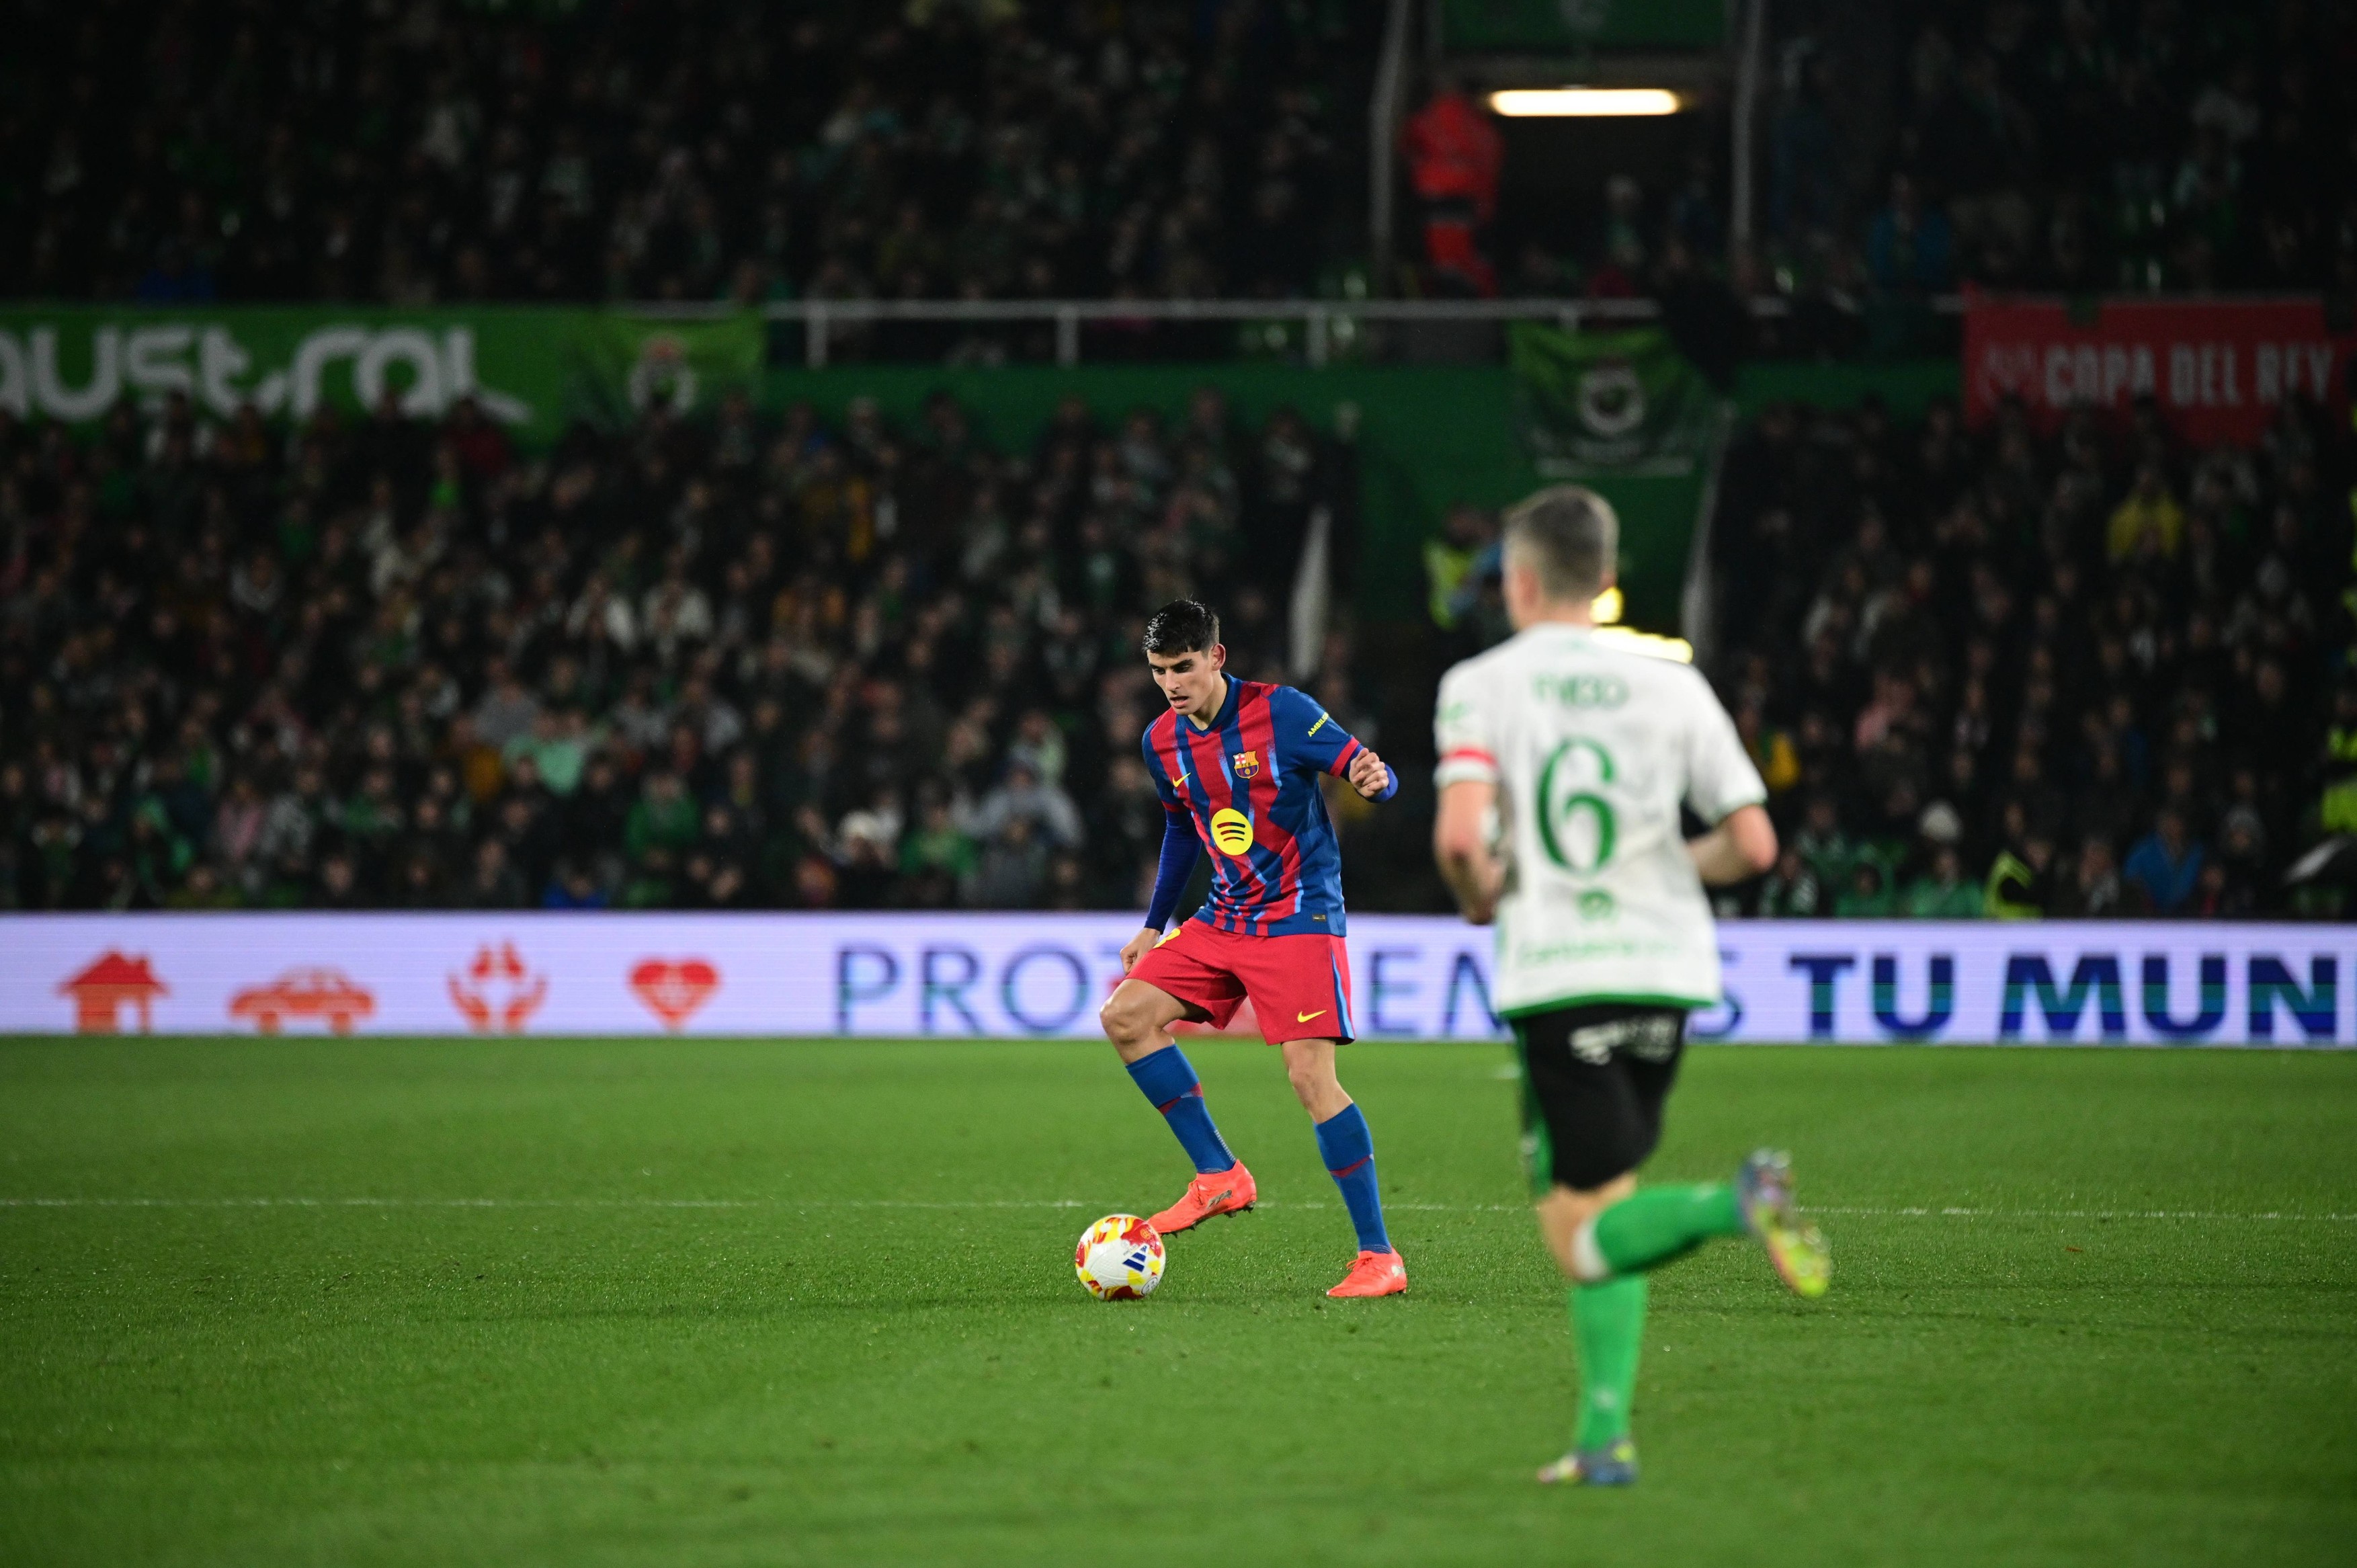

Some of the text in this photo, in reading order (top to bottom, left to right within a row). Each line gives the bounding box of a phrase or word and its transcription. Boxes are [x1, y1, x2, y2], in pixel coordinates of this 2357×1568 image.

[2044, 341, 2156, 409] COPA
[2168, 341, 2245, 407] DEL
[1537, 734, 1619, 878] 6
[1789, 952, 1954, 1040] TU
